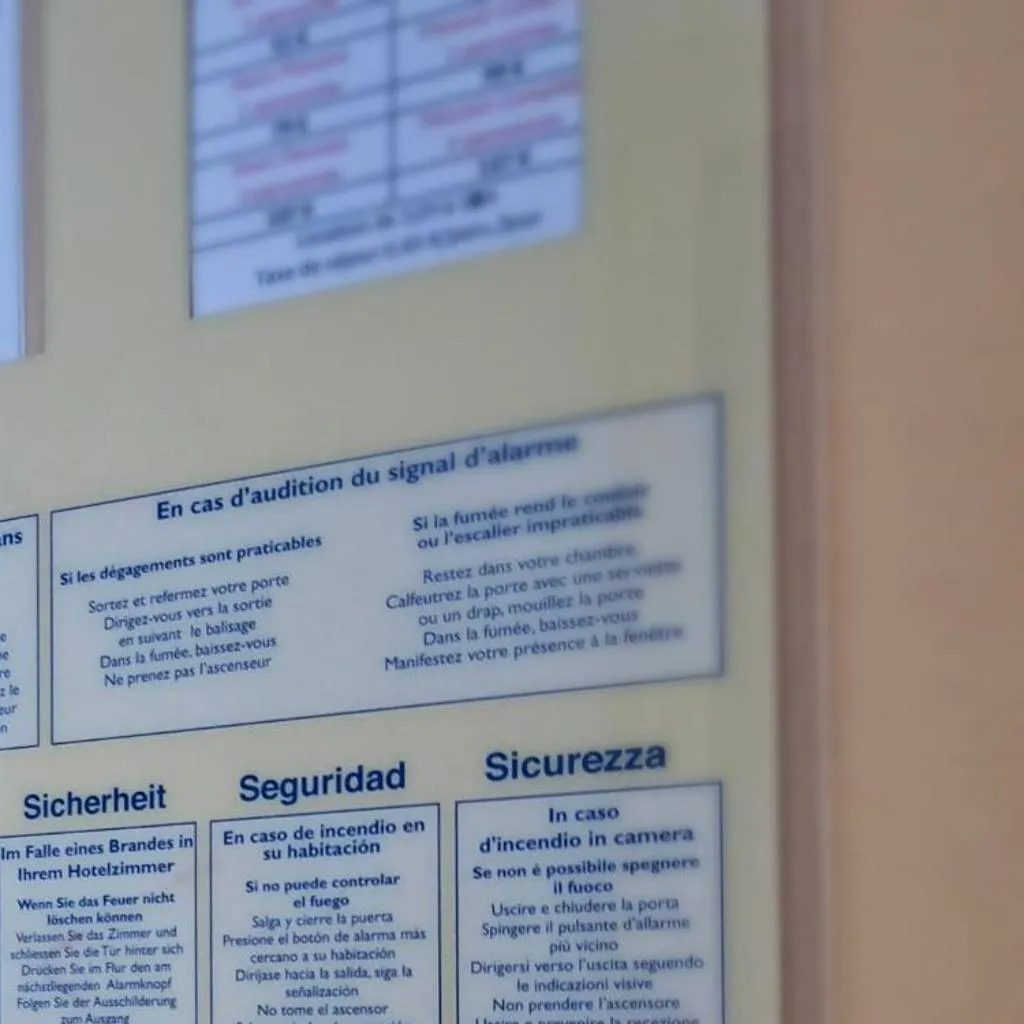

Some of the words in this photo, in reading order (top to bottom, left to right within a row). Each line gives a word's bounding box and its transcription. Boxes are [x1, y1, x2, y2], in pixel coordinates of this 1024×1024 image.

[156, 497, 183, 521] En
[189, 495, 223, 515] cas
[230, 473, 343, 508] d'audition
[351, 464, 380, 488] du
[387, 448, 455, 485] signal
[464, 435, 578, 469] d'alarme
[59, 569, 73, 586] Si
[75, 568, 96, 583] les
[99, 553, 195, 581] dégagements
[199, 546, 232, 565] sont
[236, 533, 322, 563] praticables
[88, 597, 128, 614] Sortez
[132, 592, 146, 607] et
[149, 586, 207, 605] refermez
[210, 580, 247, 596] votre
[250, 573, 289, 594] porte
[103, 609, 182, 631] Dirigez-vous
[186, 605, 213, 619] vers
[217, 599, 228, 615] la
[232, 593, 272, 613] sortie
[422, 628, 461, 646] Dans
[465, 624, 478, 641] la
[538, 609, 638, 632] baissez-vous
[103, 671, 124, 687] Ne
[126, 669, 170, 688] prenez
[173, 666, 195, 683] pas
[198, 656, 271, 676] l'ascenseur
[484, 744, 668, 783] Sicurezza
[239, 761, 407, 806] Seguridad
[23, 784, 167, 819] Sicherheit
[548, 805, 567, 823] In
[574, 806, 619, 822] caso
[222, 828, 244, 845] En
[249, 829, 287, 844] caso
[292, 823, 314, 841] de
[319, 817, 396, 839] incendio
[402, 820, 425, 833] en
[478, 829, 581, 853] d'incendio
[588, 828, 606, 847] in
[613, 827, 694, 845] camera
[0, 844, 23, 860] Im
[24, 841, 60, 859] Falle
[64, 839, 104, 856] eines
[108, 834, 174, 853] Brandes
[178, 832, 194, 849] in
[262, 847, 281, 861] su
[286, 836, 380, 859] habitación
[17, 864, 63, 881] Ihrem
[67, 859, 174, 878] Hotelzimmer
[245, 878, 258, 893] Si
[261, 881, 280, 892] no
[283, 875, 327, 894] puede
[331, 871, 400, 888] controlar
[16, 896, 54, 910] Wenn
[55, 894, 75, 908] Sie
[77, 893, 99, 907] das
[101, 892, 139, 906] Feuer
[141, 889, 175, 904] nicht
[552, 878, 563, 894] il
[567, 878, 613, 894] fuoco
[292, 893, 306, 908] el
[309, 893, 349, 910] fuego
[490, 900, 536, 917] Uscire
[553, 896, 616, 914] chiudere
[620, 895, 633, 911] la
[637, 895, 679, 914] porta
[46, 911, 93, 925] löschen
[95, 909, 143, 923] können
[251, 913, 281, 932] Salga
[295, 911, 333, 927] cierre
[335, 909, 347, 925] la
[350, 910, 393, 928] puerta
